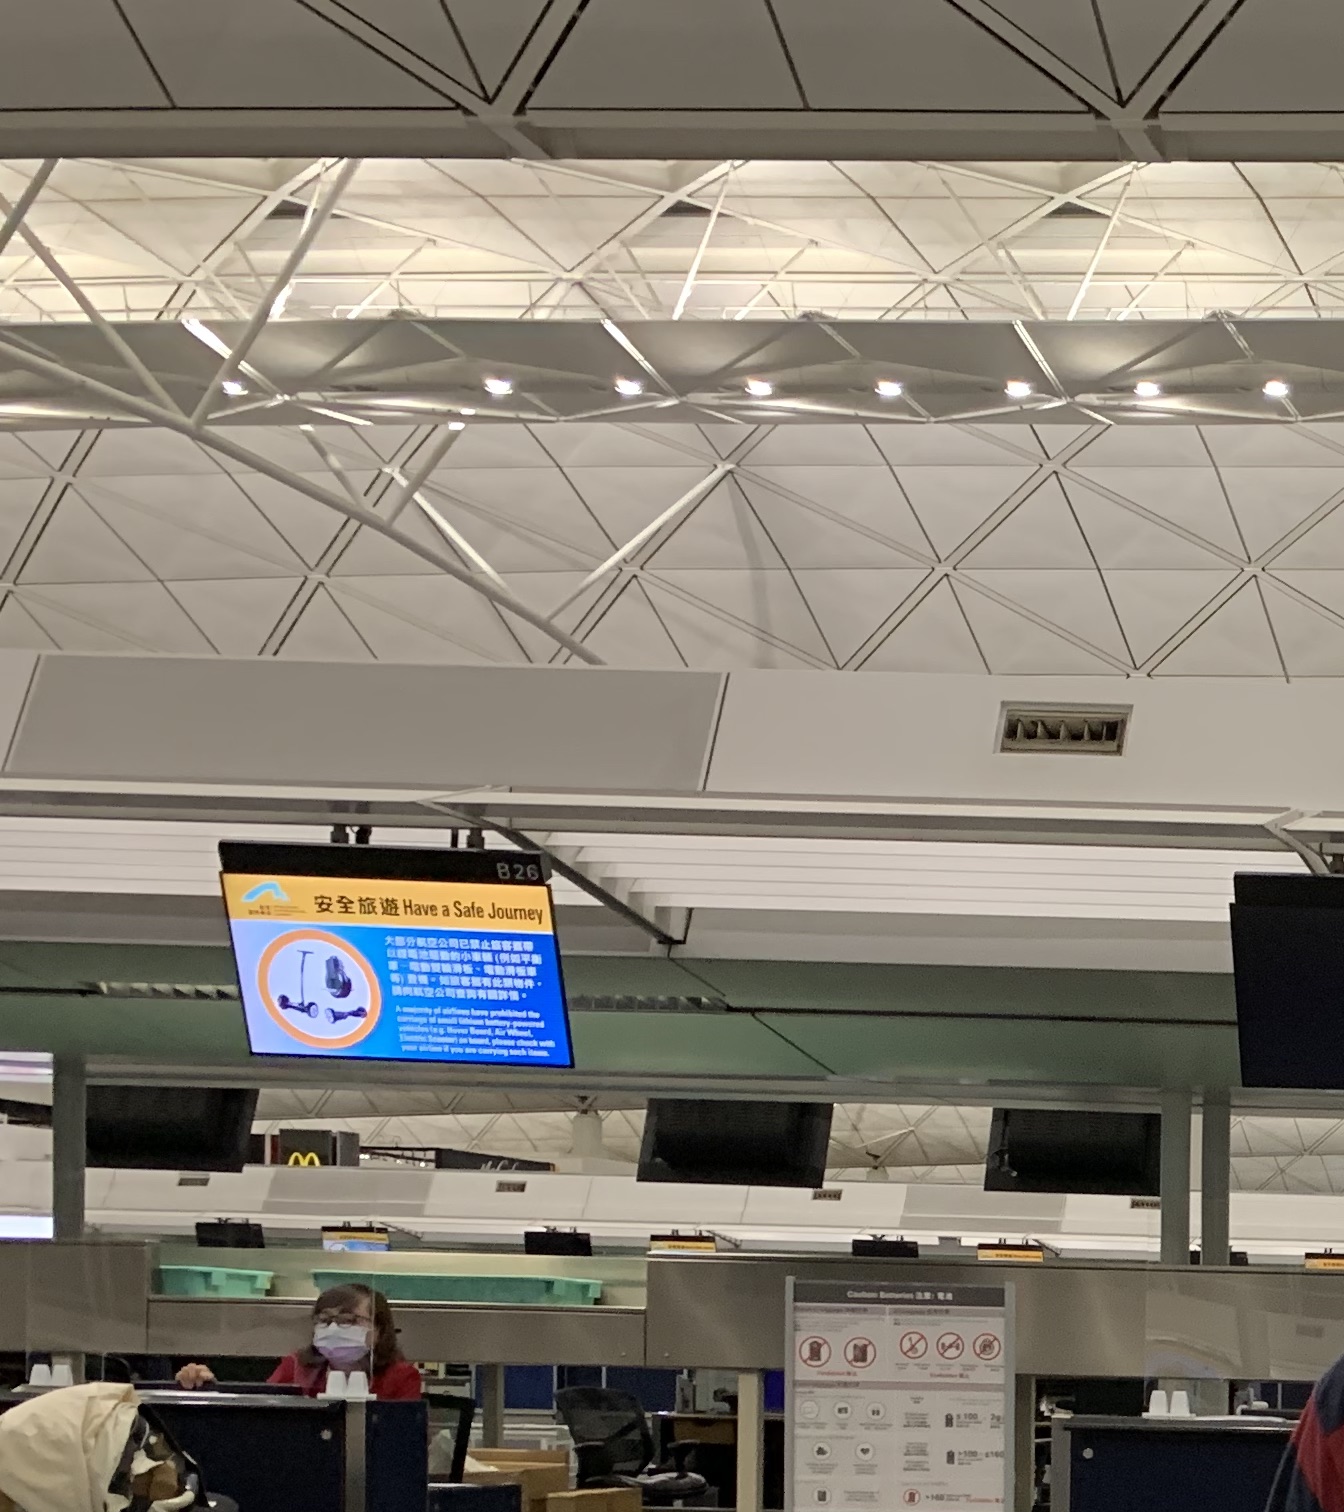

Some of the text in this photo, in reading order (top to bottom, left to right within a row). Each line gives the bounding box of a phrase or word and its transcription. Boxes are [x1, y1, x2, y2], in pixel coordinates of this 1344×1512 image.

[496, 863, 539, 881] B26
[314, 895, 400, 916] 安全旅遊
[403, 899, 440, 917] Have
[441, 903, 451, 916] a
[453, 900, 485, 919] Safe
[487, 902, 544, 924] Journey
